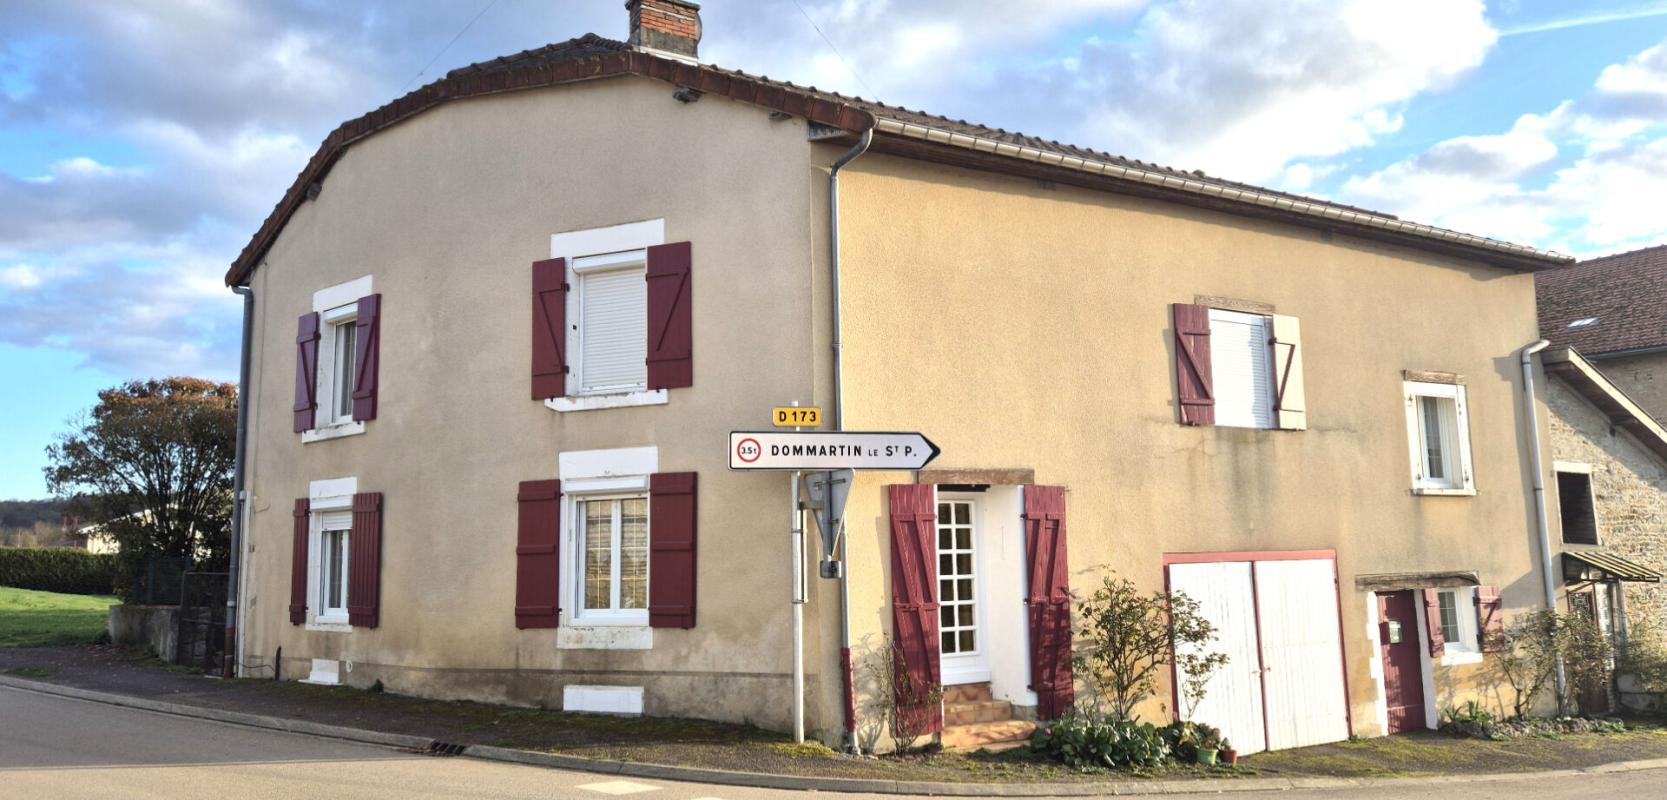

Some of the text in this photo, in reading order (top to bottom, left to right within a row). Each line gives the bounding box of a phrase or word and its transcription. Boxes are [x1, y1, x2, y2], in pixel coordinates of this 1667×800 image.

[778, 411, 816, 422] D 173
[771, 445, 862, 456] DOMMARTIN
[904, 446, 917, 456] P.
